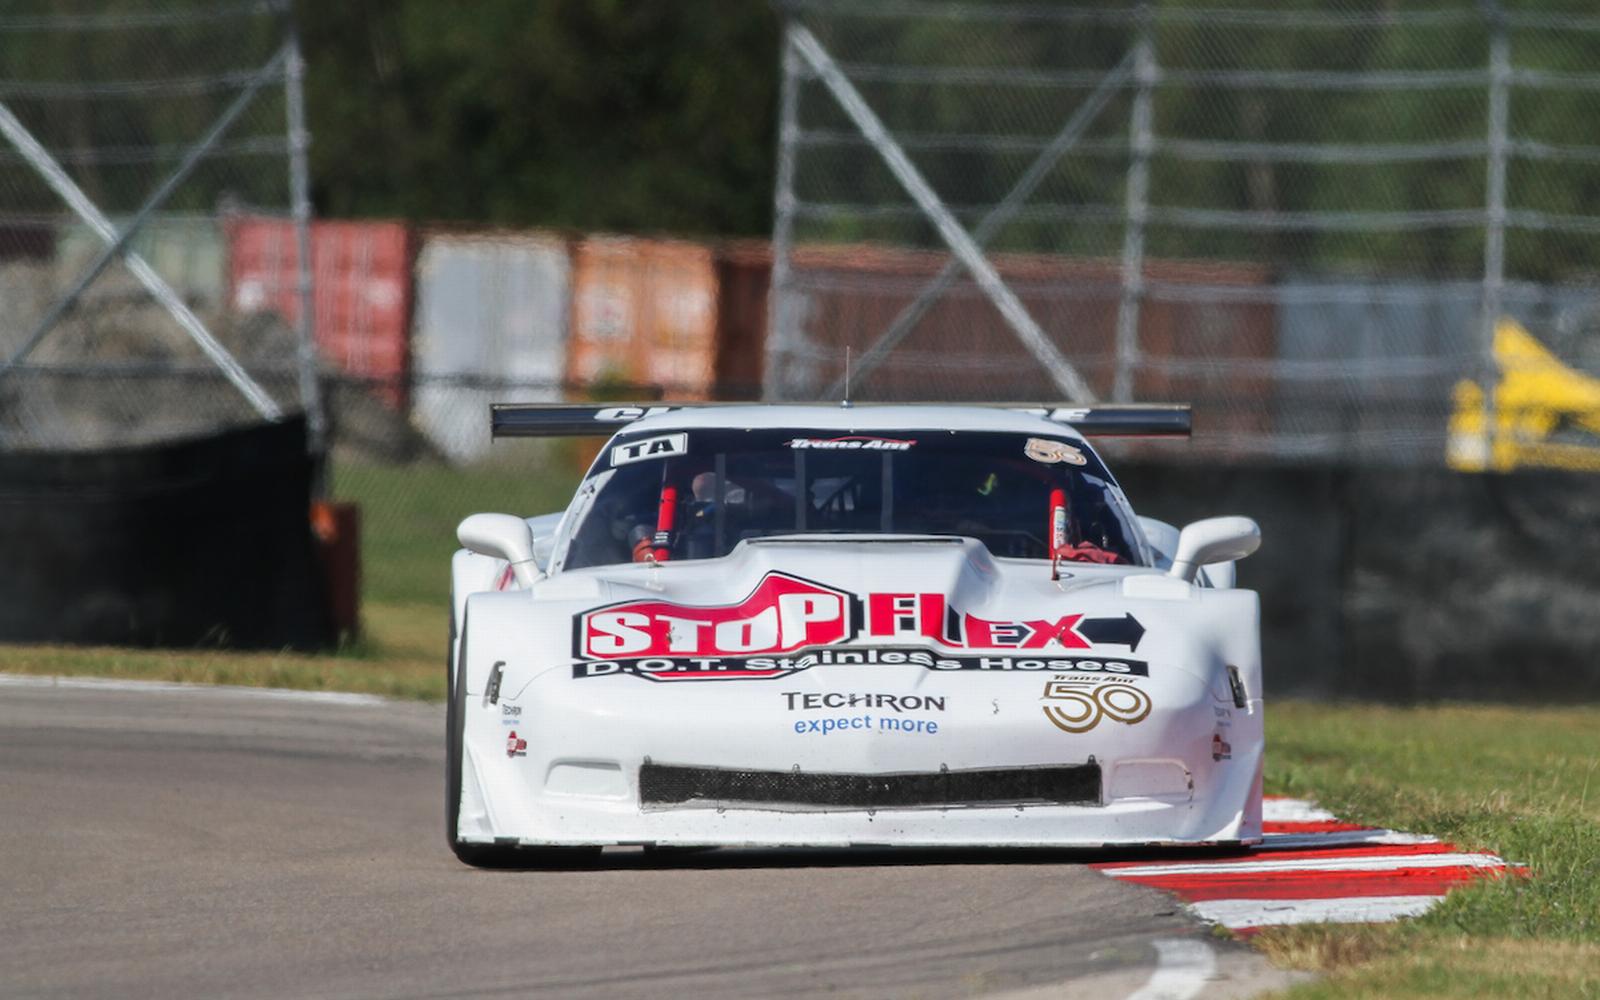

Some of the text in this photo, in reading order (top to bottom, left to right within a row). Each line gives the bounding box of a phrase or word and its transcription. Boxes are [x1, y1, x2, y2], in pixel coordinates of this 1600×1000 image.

[622, 438, 675, 459] TA
[790, 438, 911, 450] Trans Am
[589, 592, 1092, 654] STOP FLEX
[587, 649, 1132, 675] D.O.T. Stainless Hoses
[781, 691, 946, 712] TECHRON
[1042, 681, 1153, 734] 50
[794, 715, 938, 735] expect more
